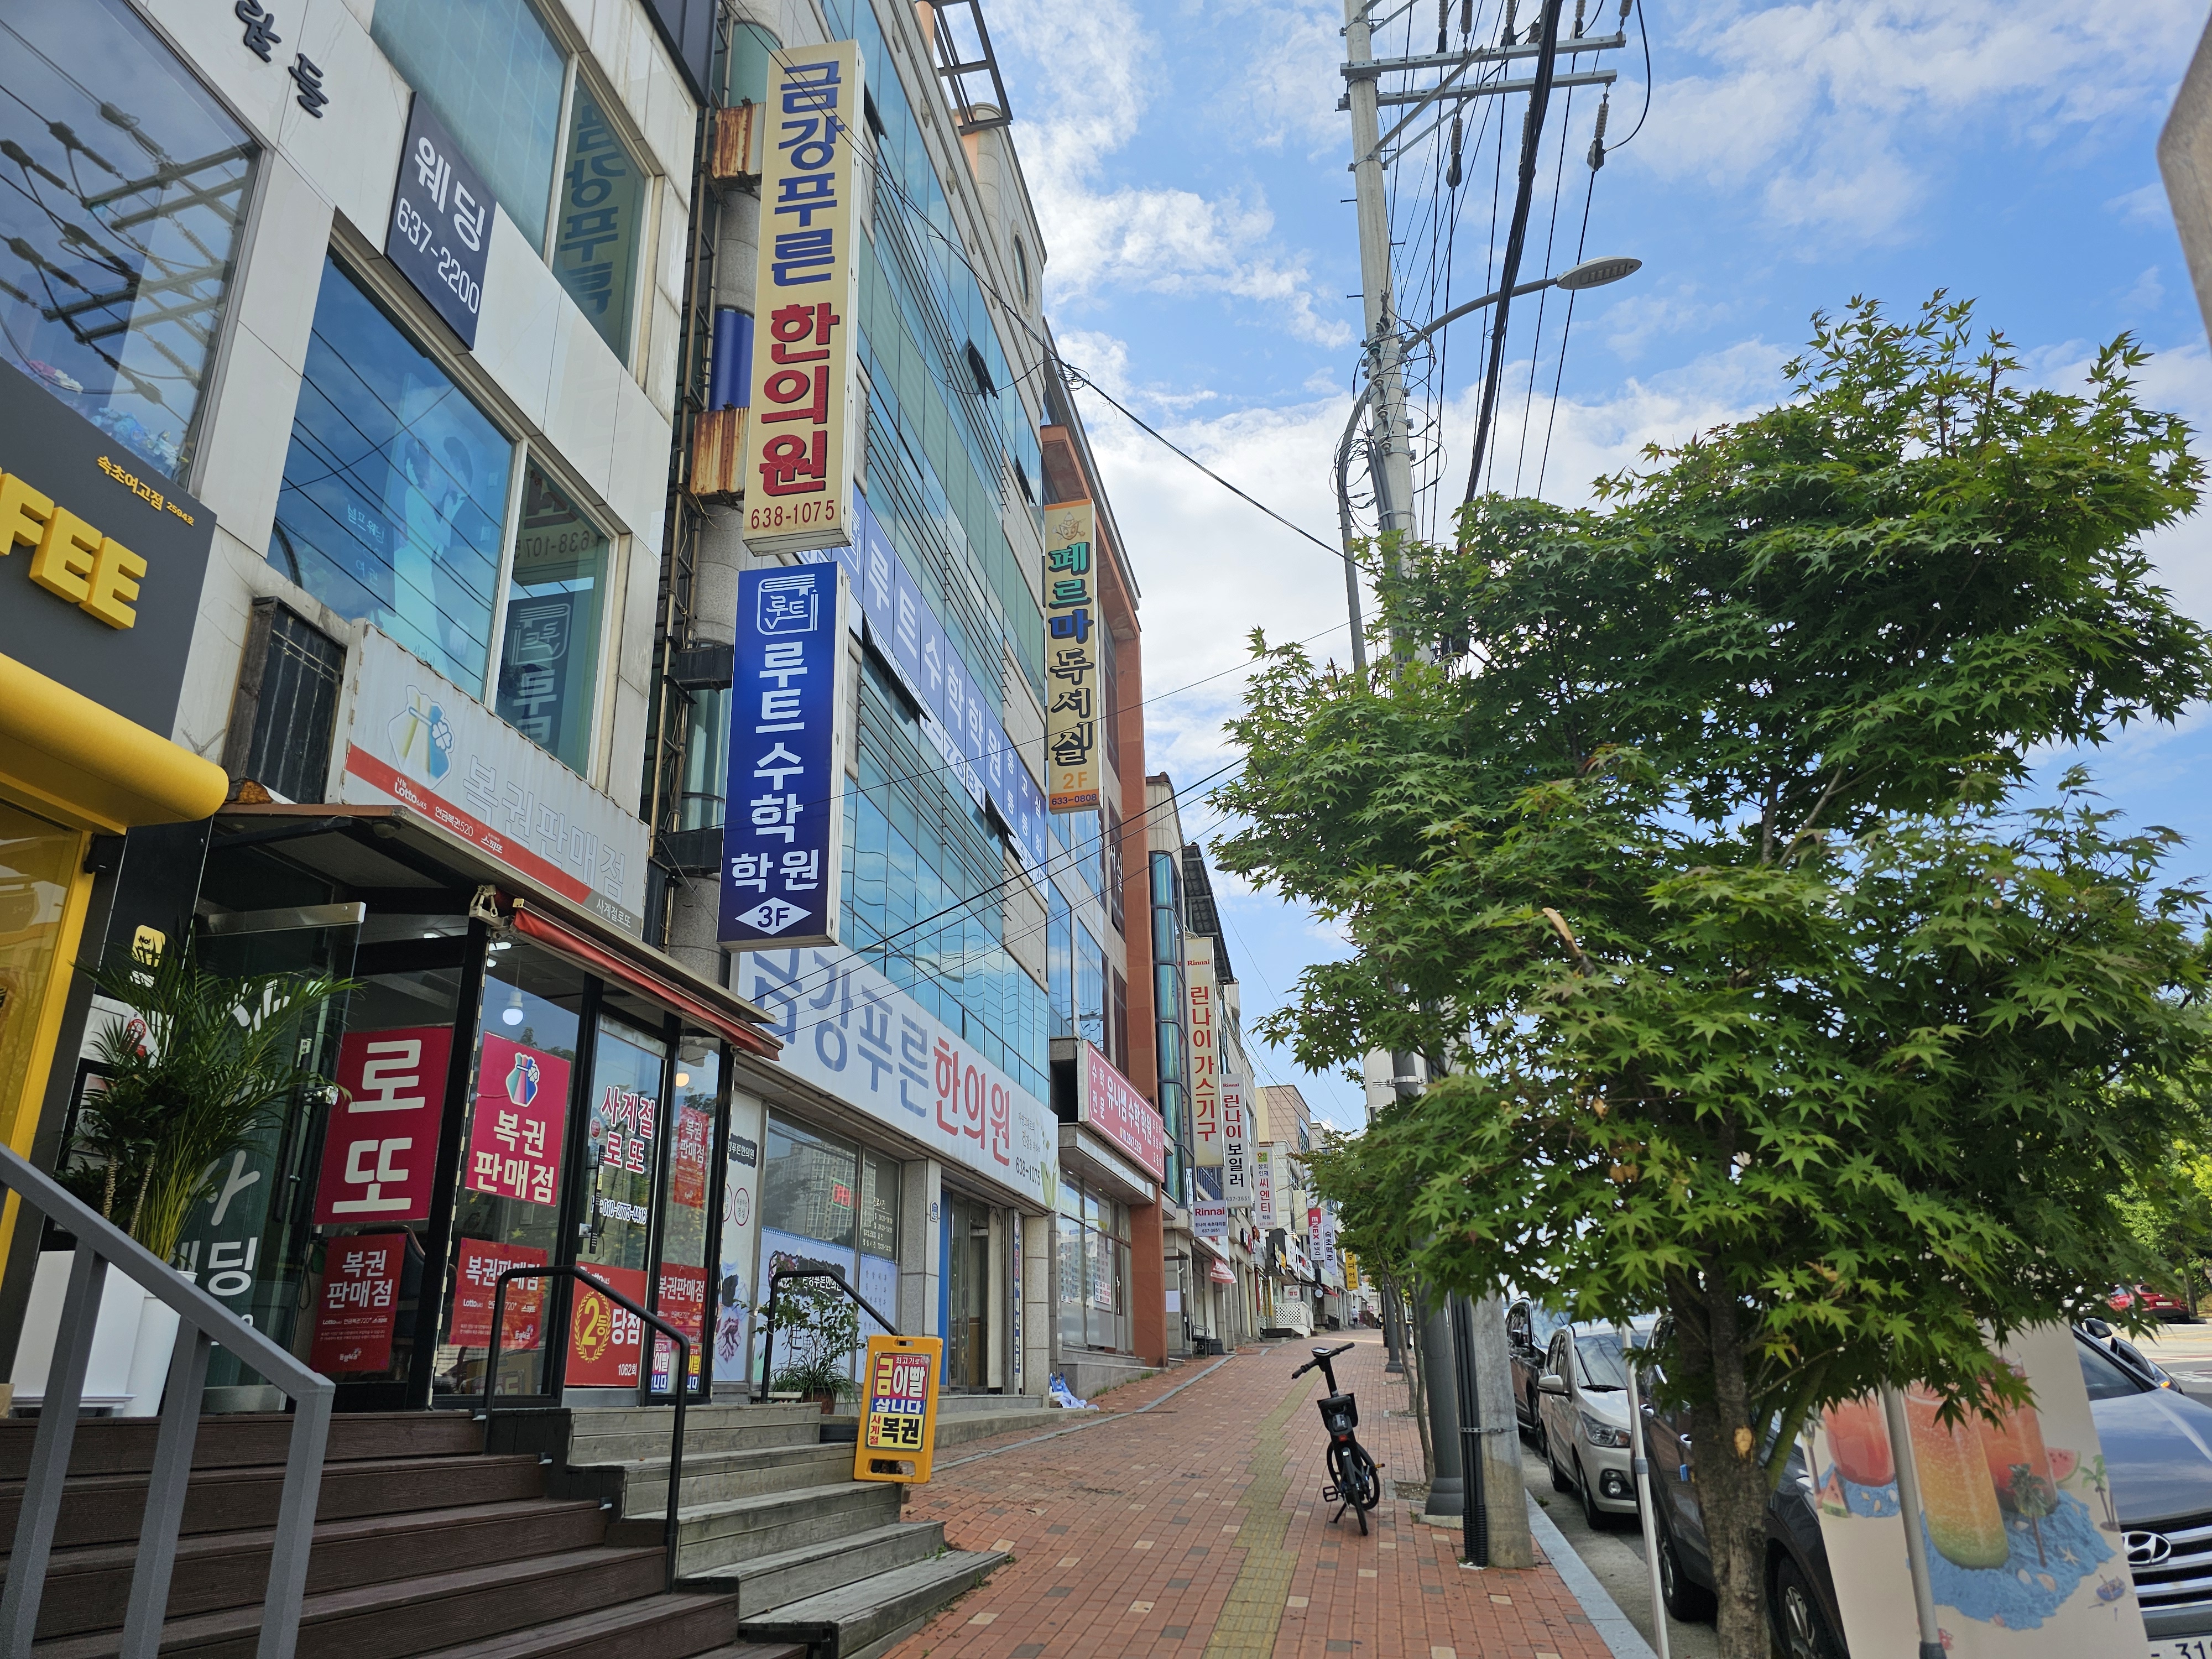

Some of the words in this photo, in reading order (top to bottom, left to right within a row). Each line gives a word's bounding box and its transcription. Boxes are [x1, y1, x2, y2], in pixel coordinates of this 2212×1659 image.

[771, 60, 845, 287] 금강푸른
[414, 137, 486, 252] 웨딩
[397, 197, 480, 314] 637-2200
[759, 302, 840, 497] 한의원
[97, 455, 164, 511] 속초여고점
[166, 501, 195, 526] 2594호
[751, 499, 834, 529] 638-1075
[1048, 541, 1095, 766] 페르마독서실
[750, 641, 808, 843] 루트수학
[394, 782, 417, 804] Lotto
[416, 799, 427, 810] 6/45
[1062, 771, 1088, 790] 2F
[1051, 793, 1097, 806] 633-0808
[435, 806, 474, 837] 연금복권520
[463, 754, 626, 905] 복권판매점
[480, 836, 503, 854] 스피또
[731, 849, 820, 893] 학원
[596, 899, 631, 928] 사계절로또
[757, 905, 790, 928] 3F
[1190, 986, 1212, 1048] 린나이
[601, 1086, 655, 1140] 사계절
[933, 1036, 1011, 1167] 한의원
[1194, 1055, 1217, 1142] 가스기구
[332, 1039, 425, 1213] 로또
[685, 1119, 702, 1142] 복권
[1128, 1097, 1152, 1145] 수학학원
[1223, 1094, 1241, 1138] 린나이
[493, 1109, 546, 1159] 복권
[603, 1130, 645, 1175] 로또
[680, 1139, 705, 1165] 판매점
[1228, 1143, 1244, 1187] 보일러
[474, 1151, 555, 1204] 판매점
[1015, 1156, 1041, 1186] 638-1075
[1259, 1178, 1271, 1213] 씨엔티
[1194, 1207, 1225, 1216] Rinnai
[1311, 1216, 1319, 1239] ENEX
[342, 1249, 387, 1278] 복권
[327, 1279, 393, 1309] 판매점
[463, 1298, 477, 1307] Lotto
[659, 1275, 705, 1303] 복권판매점
[581, 1297, 608, 1346] 2등
[618, 1363, 638, 1376] 1062회
[653, 1352, 669, 1373] 이빨
[895, 1356, 920, 1365] 최고가로
[651, 1374, 667, 1390] 니다
[877, 1357, 926, 1398] 금이빨
[875, 1398, 922, 1415] 삽니다
[869, 1415, 881, 1446] 사계절
[881, 1417, 920, 1445] 복권
